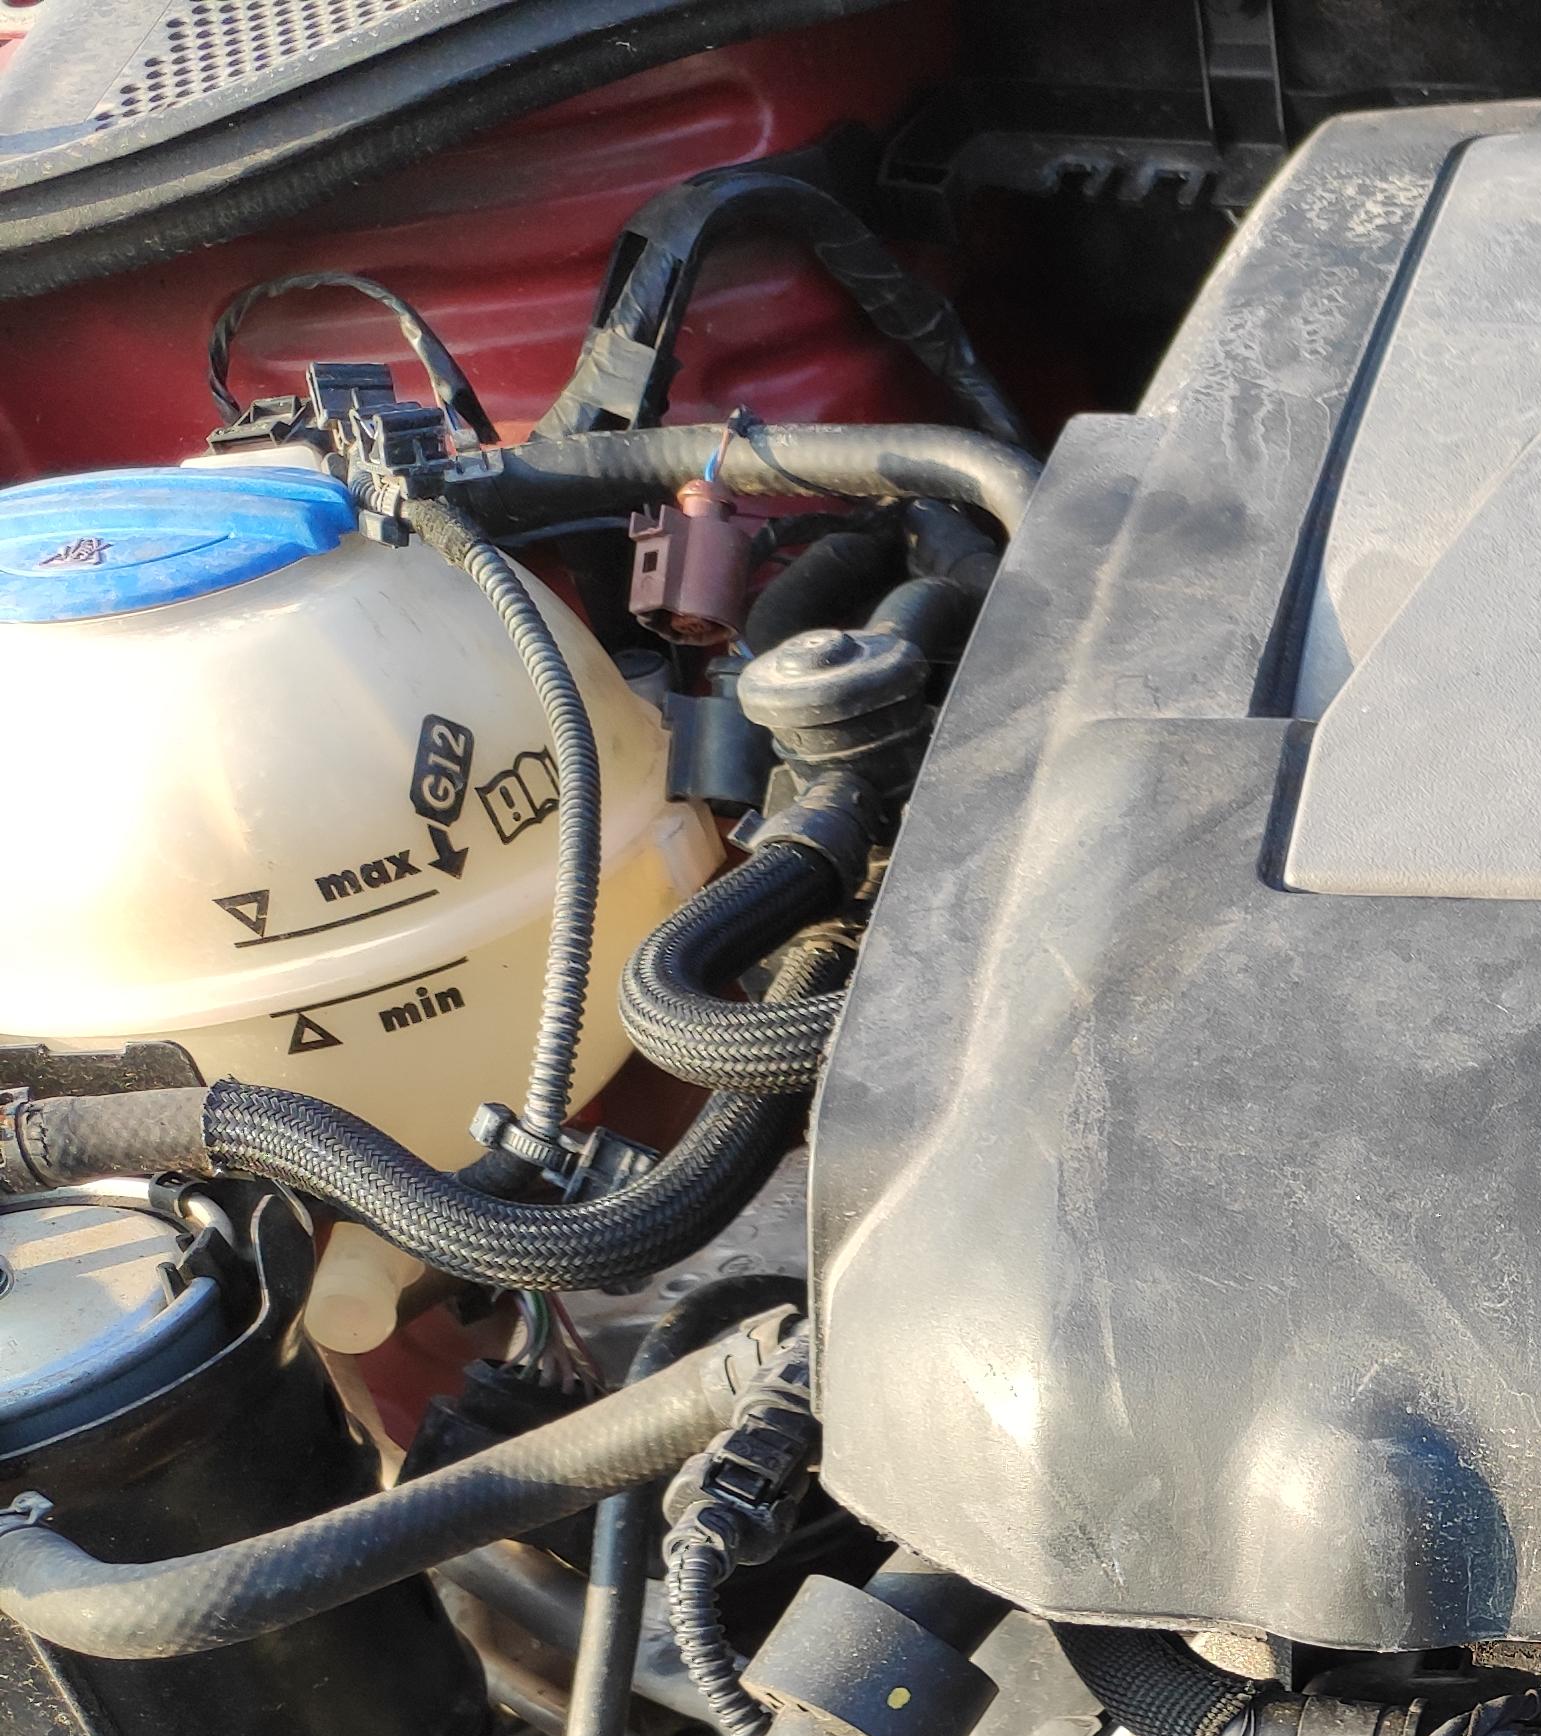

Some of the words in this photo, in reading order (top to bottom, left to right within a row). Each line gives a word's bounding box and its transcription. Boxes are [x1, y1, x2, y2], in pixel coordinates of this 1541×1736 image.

[420, 724, 465, 810] G12
[314, 850, 422, 902] max
[379, 987, 465, 1033] min
